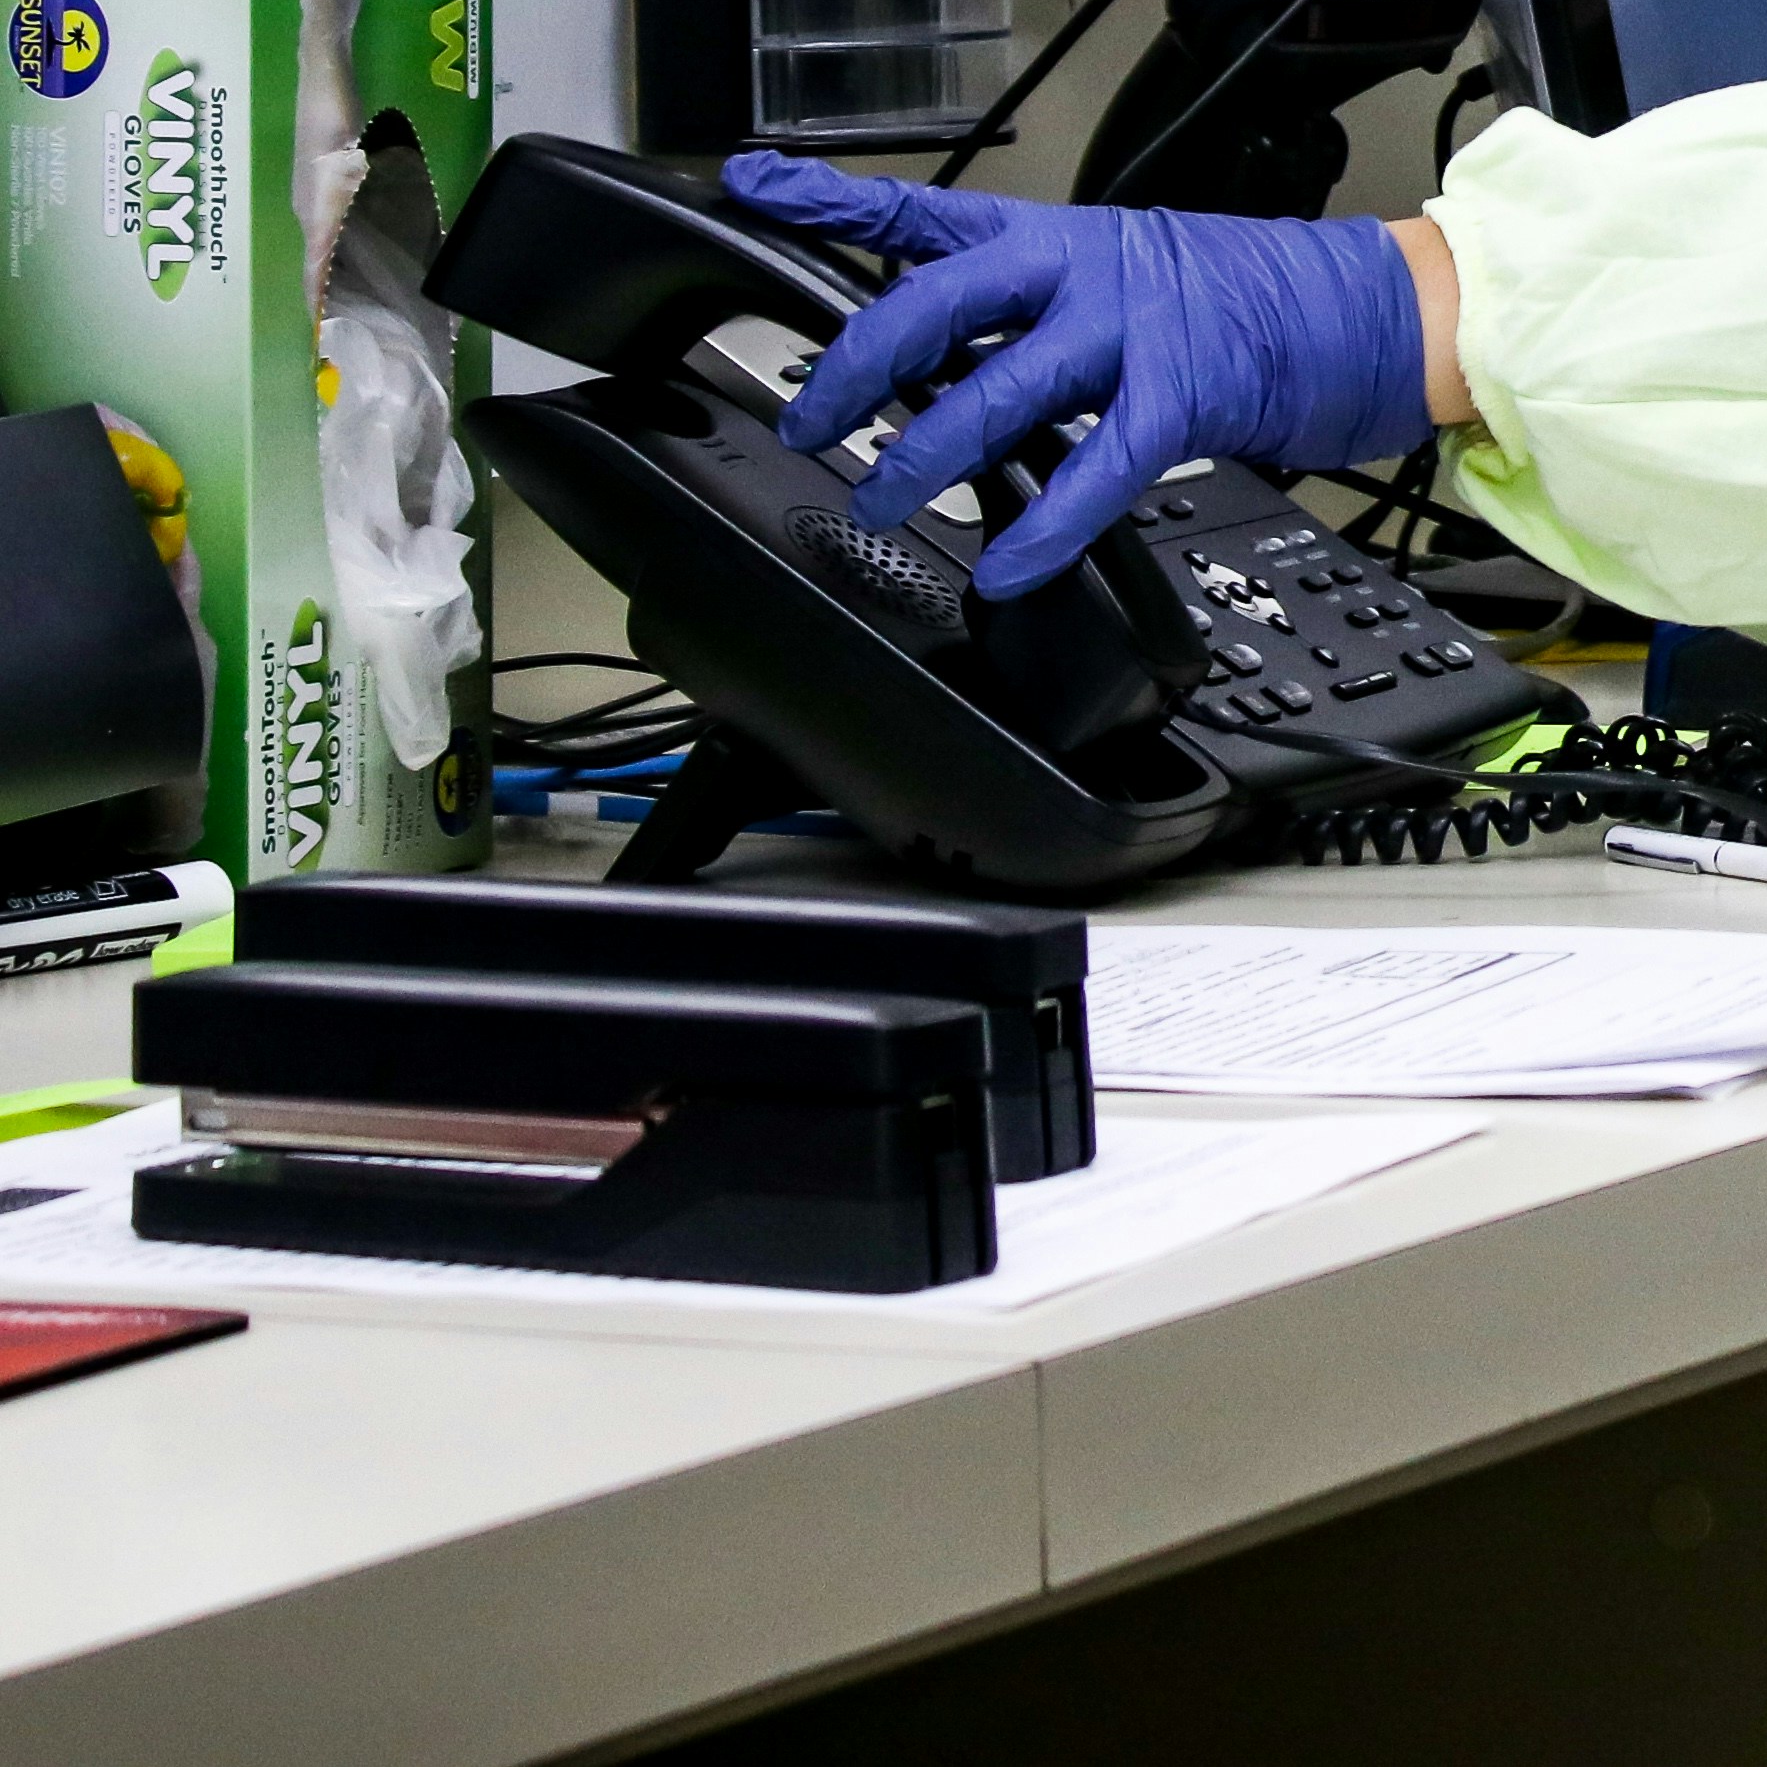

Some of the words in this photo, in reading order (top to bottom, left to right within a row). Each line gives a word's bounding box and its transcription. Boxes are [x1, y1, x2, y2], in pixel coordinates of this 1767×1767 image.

[469, 0, 478, 85] MEDIUM
[108, 132, 117, 216] POWDERED
[124, 114, 142, 234] GLOVES
[147, 69, 196, 282] VINYL
[209, 87, 229, 272] SmoothTouch
[260, 641, 276, 855] SmoothTouch
[286, 620, 324, 869] VINYL
[327, 669, 341, 806] GLOVES
[39, 889, 81, 905] erase
